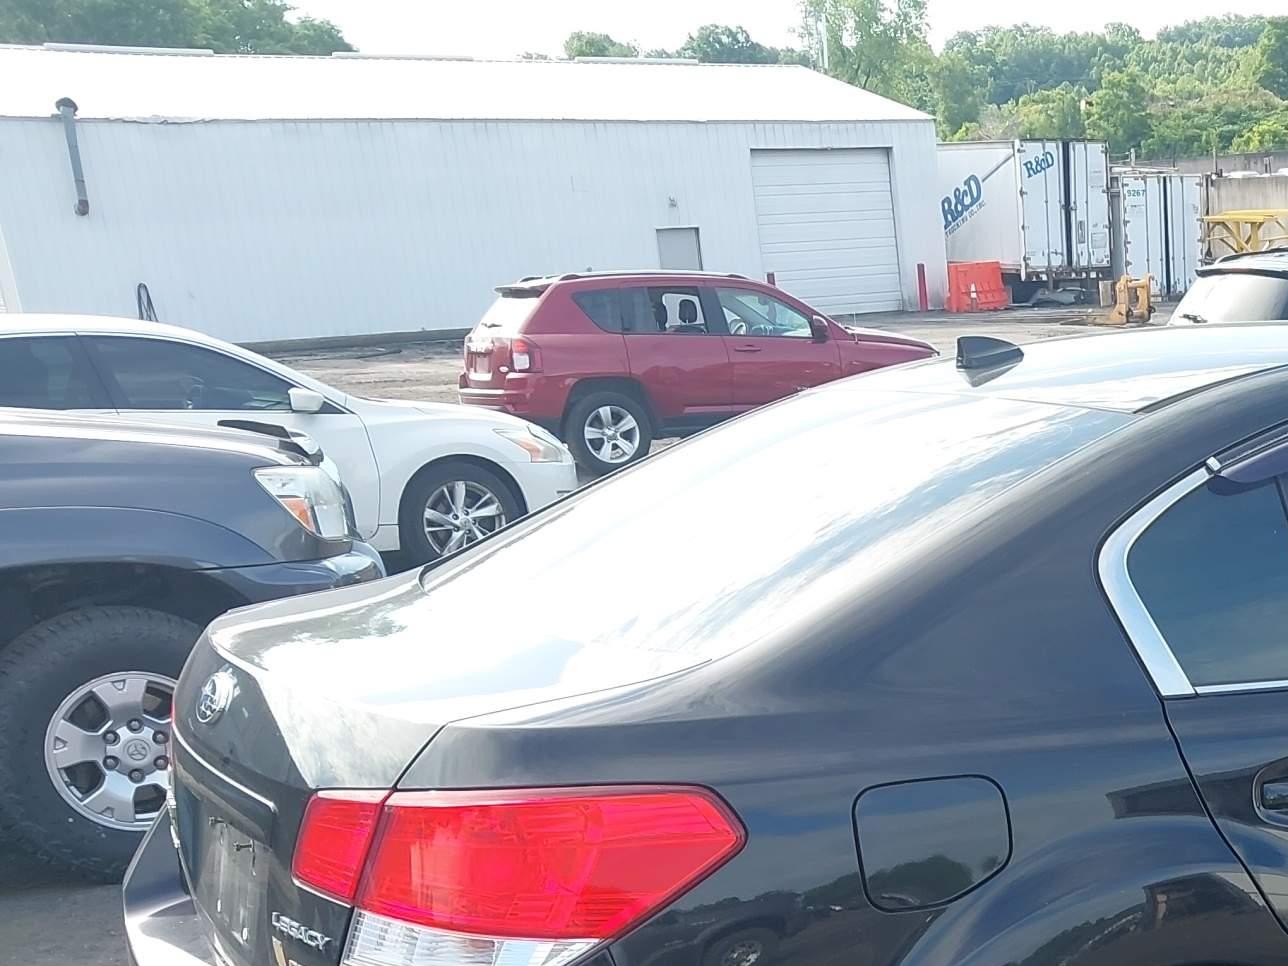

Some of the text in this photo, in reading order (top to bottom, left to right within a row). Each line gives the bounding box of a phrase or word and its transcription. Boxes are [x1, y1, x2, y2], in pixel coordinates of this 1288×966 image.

[1023, 151, 1055, 178] R&D
[941, 174, 982, 230] R&D
[271, 911, 333, 950] LEGACY
